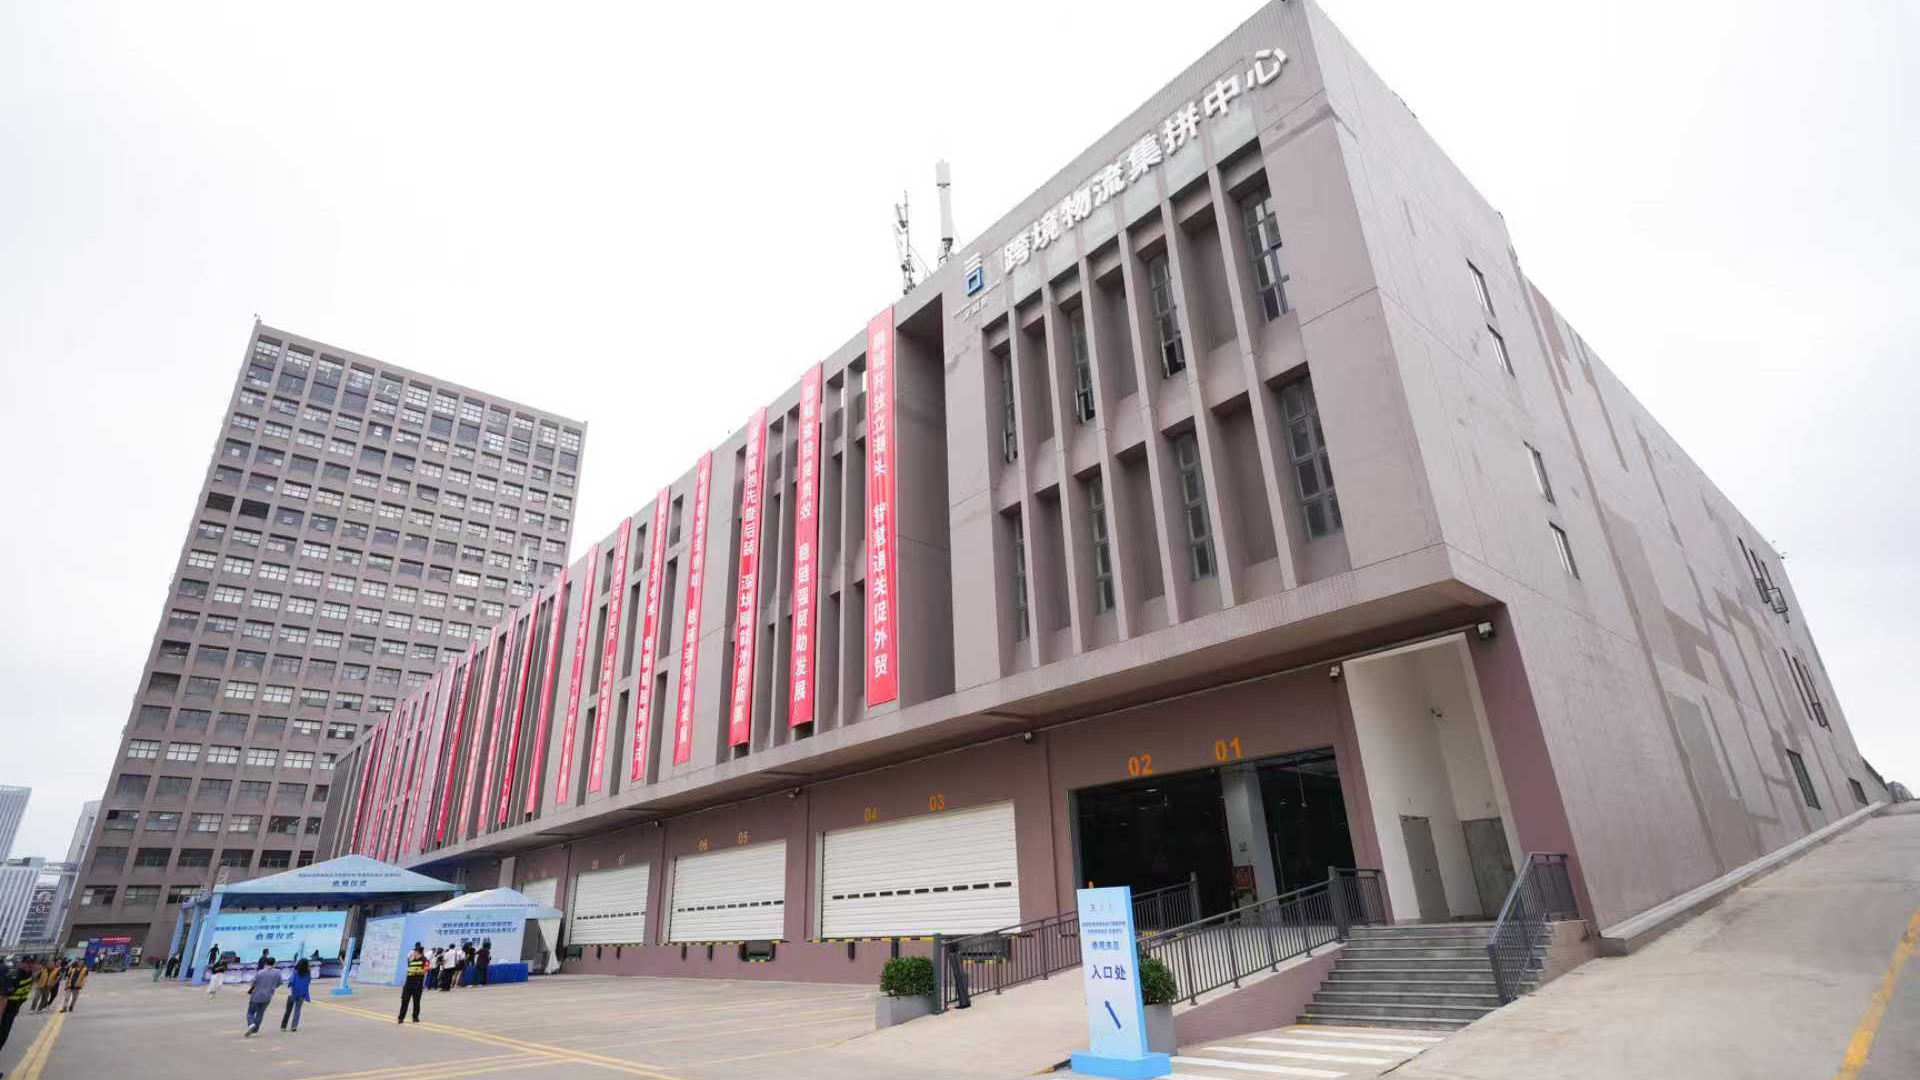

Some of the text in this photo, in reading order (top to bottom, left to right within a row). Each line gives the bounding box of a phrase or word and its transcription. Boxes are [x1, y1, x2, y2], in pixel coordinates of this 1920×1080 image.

[1003, 47, 1290, 274] 跨境物流集拼中心
[872, 501, 888, 678] 智慧通关促外贸
[1215, 735, 1242, 762] 01
[1128, 752, 1152, 778] 02
[864, 806, 879, 821] 04
[929, 792, 945, 812] 03
[738, 831, 749, 845] 05
[1091, 964, 1127, 981] 入口处
